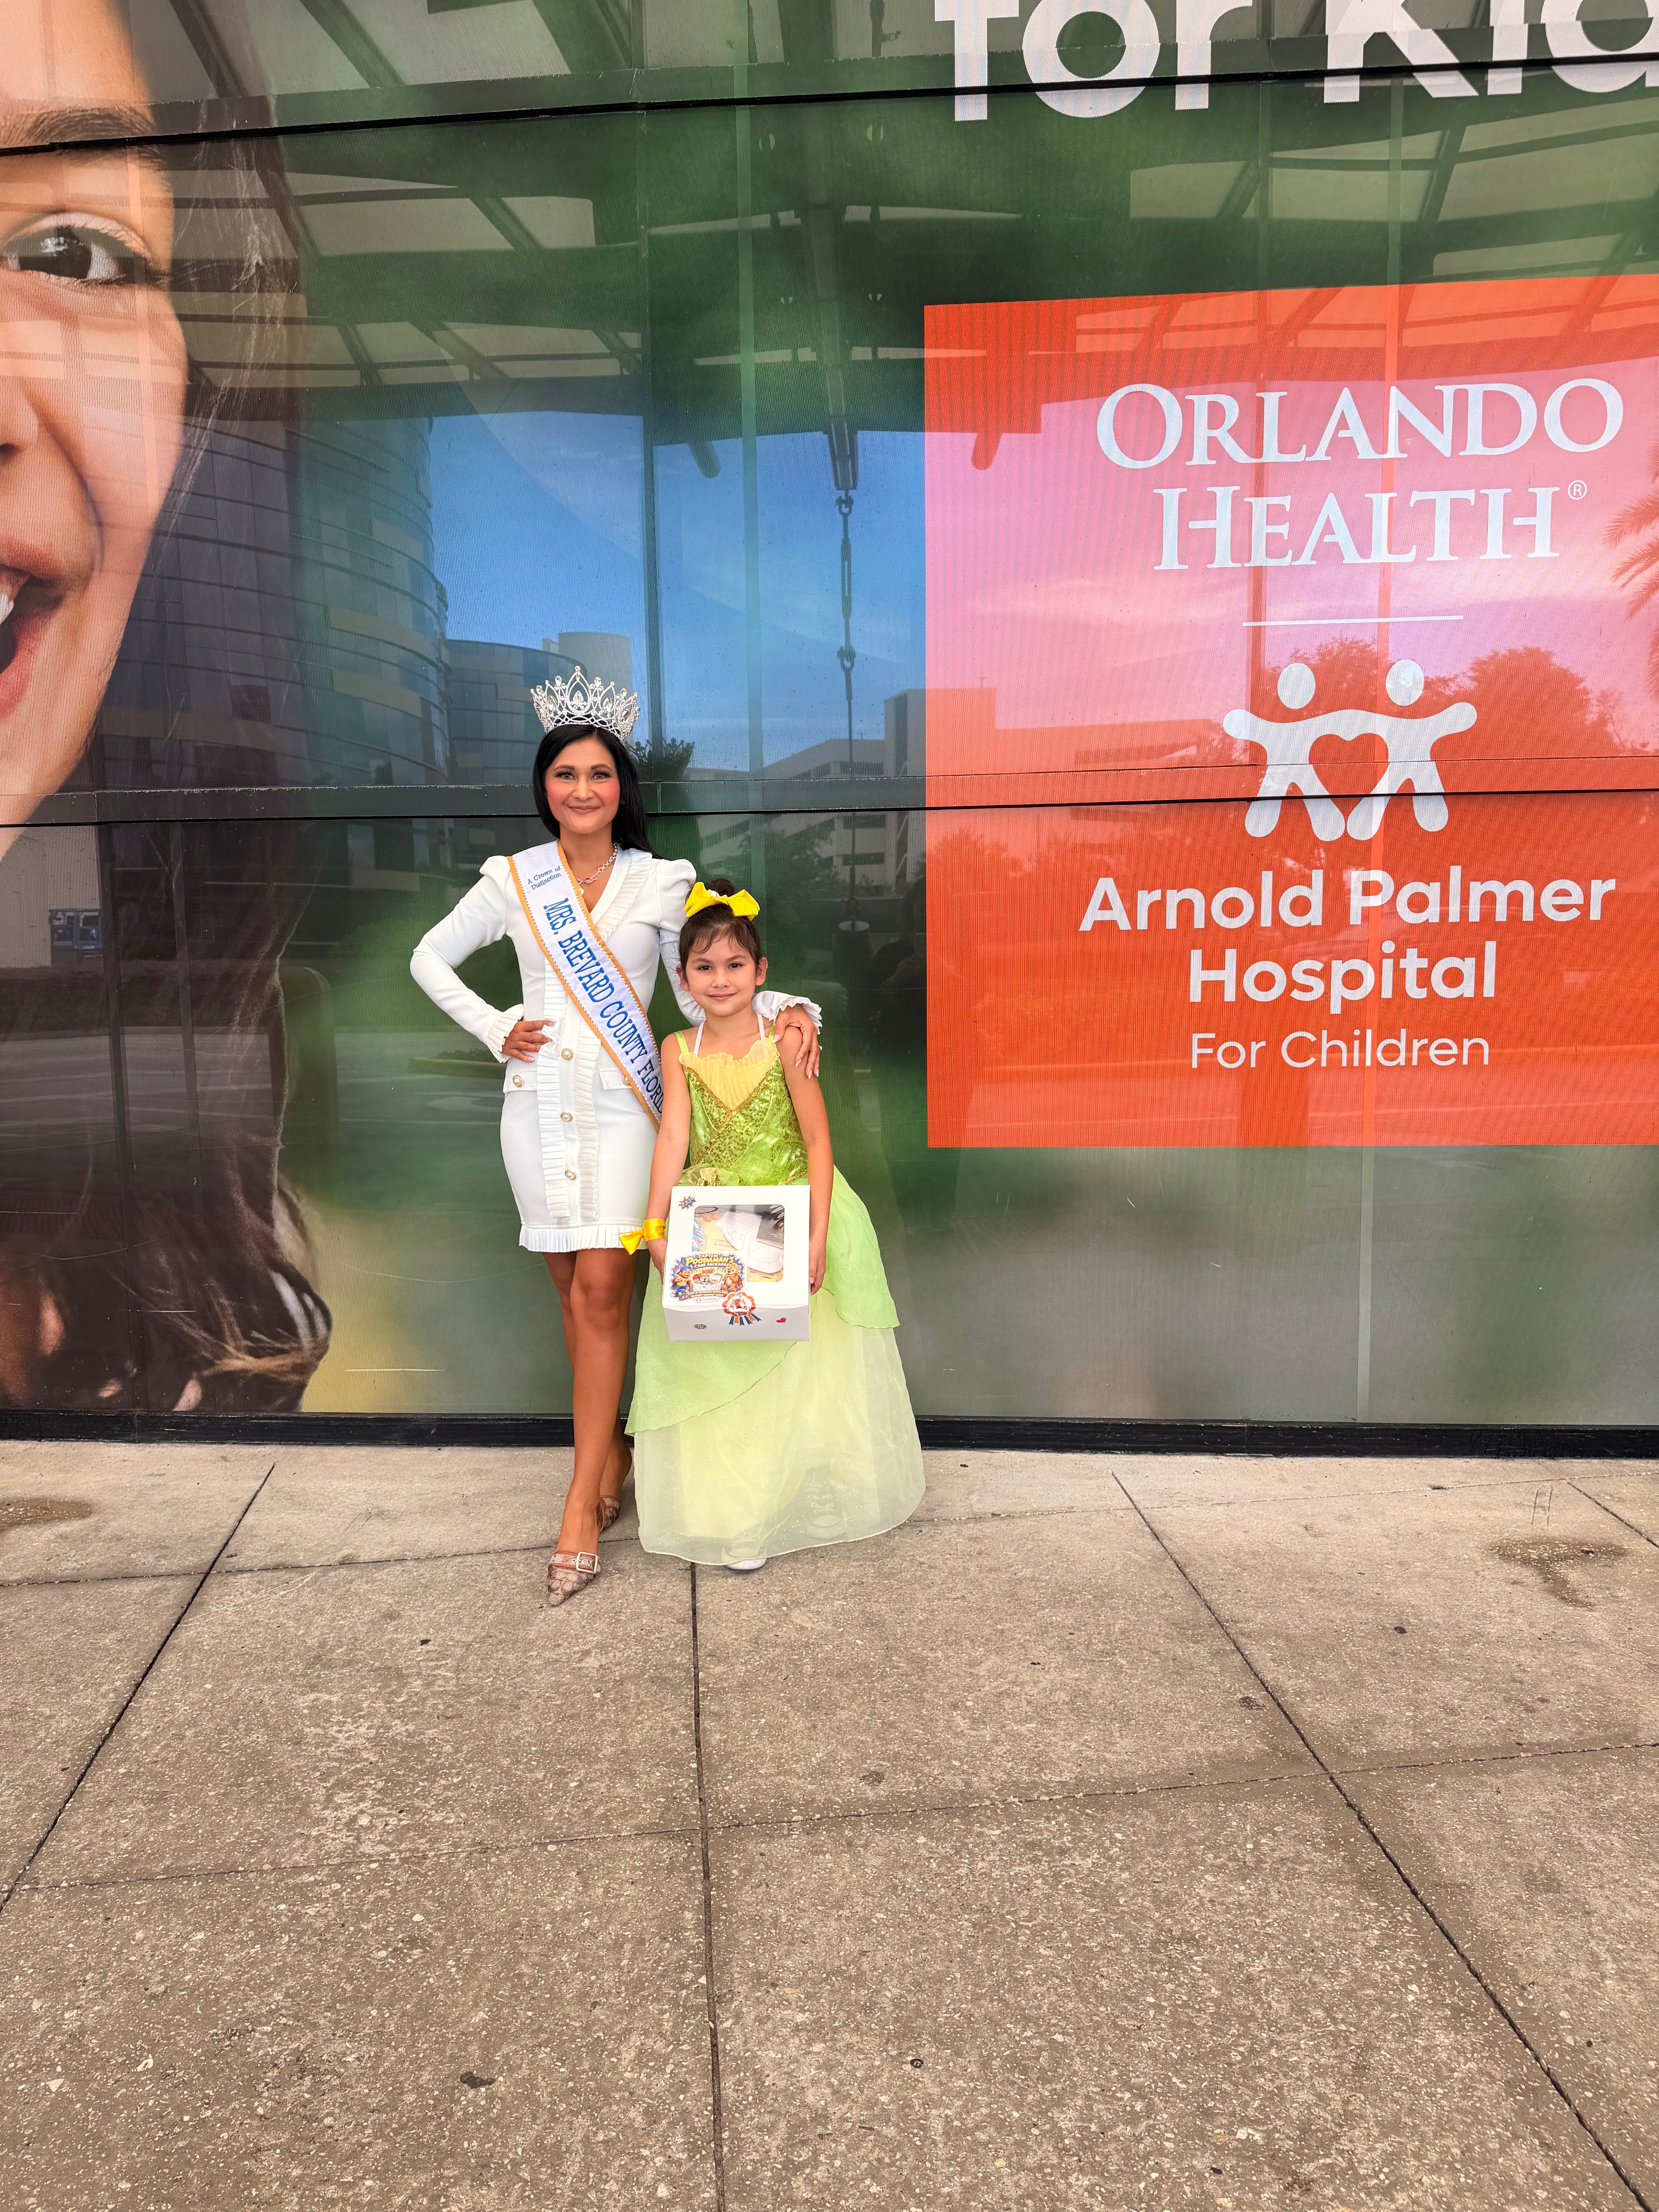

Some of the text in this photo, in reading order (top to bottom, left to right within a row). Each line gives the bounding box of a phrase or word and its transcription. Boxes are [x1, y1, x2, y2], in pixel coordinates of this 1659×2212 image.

[934, 0, 1253, 122] for
[1096, 378, 1624, 469] ORLANDO
[531, 872, 562, 890] Distinction
[533, 869, 553, 881] Crown
[1079, 865, 1616, 931] Arnold Palmer
[543, 897, 664, 1117] MRS. BREVARD COUNTY FLORI
[1189, 940, 1497, 1015] Hospital
[1191, 1028, 1490, 1069] For Children
[685, 1256, 735, 1266] POODAMAN'S
